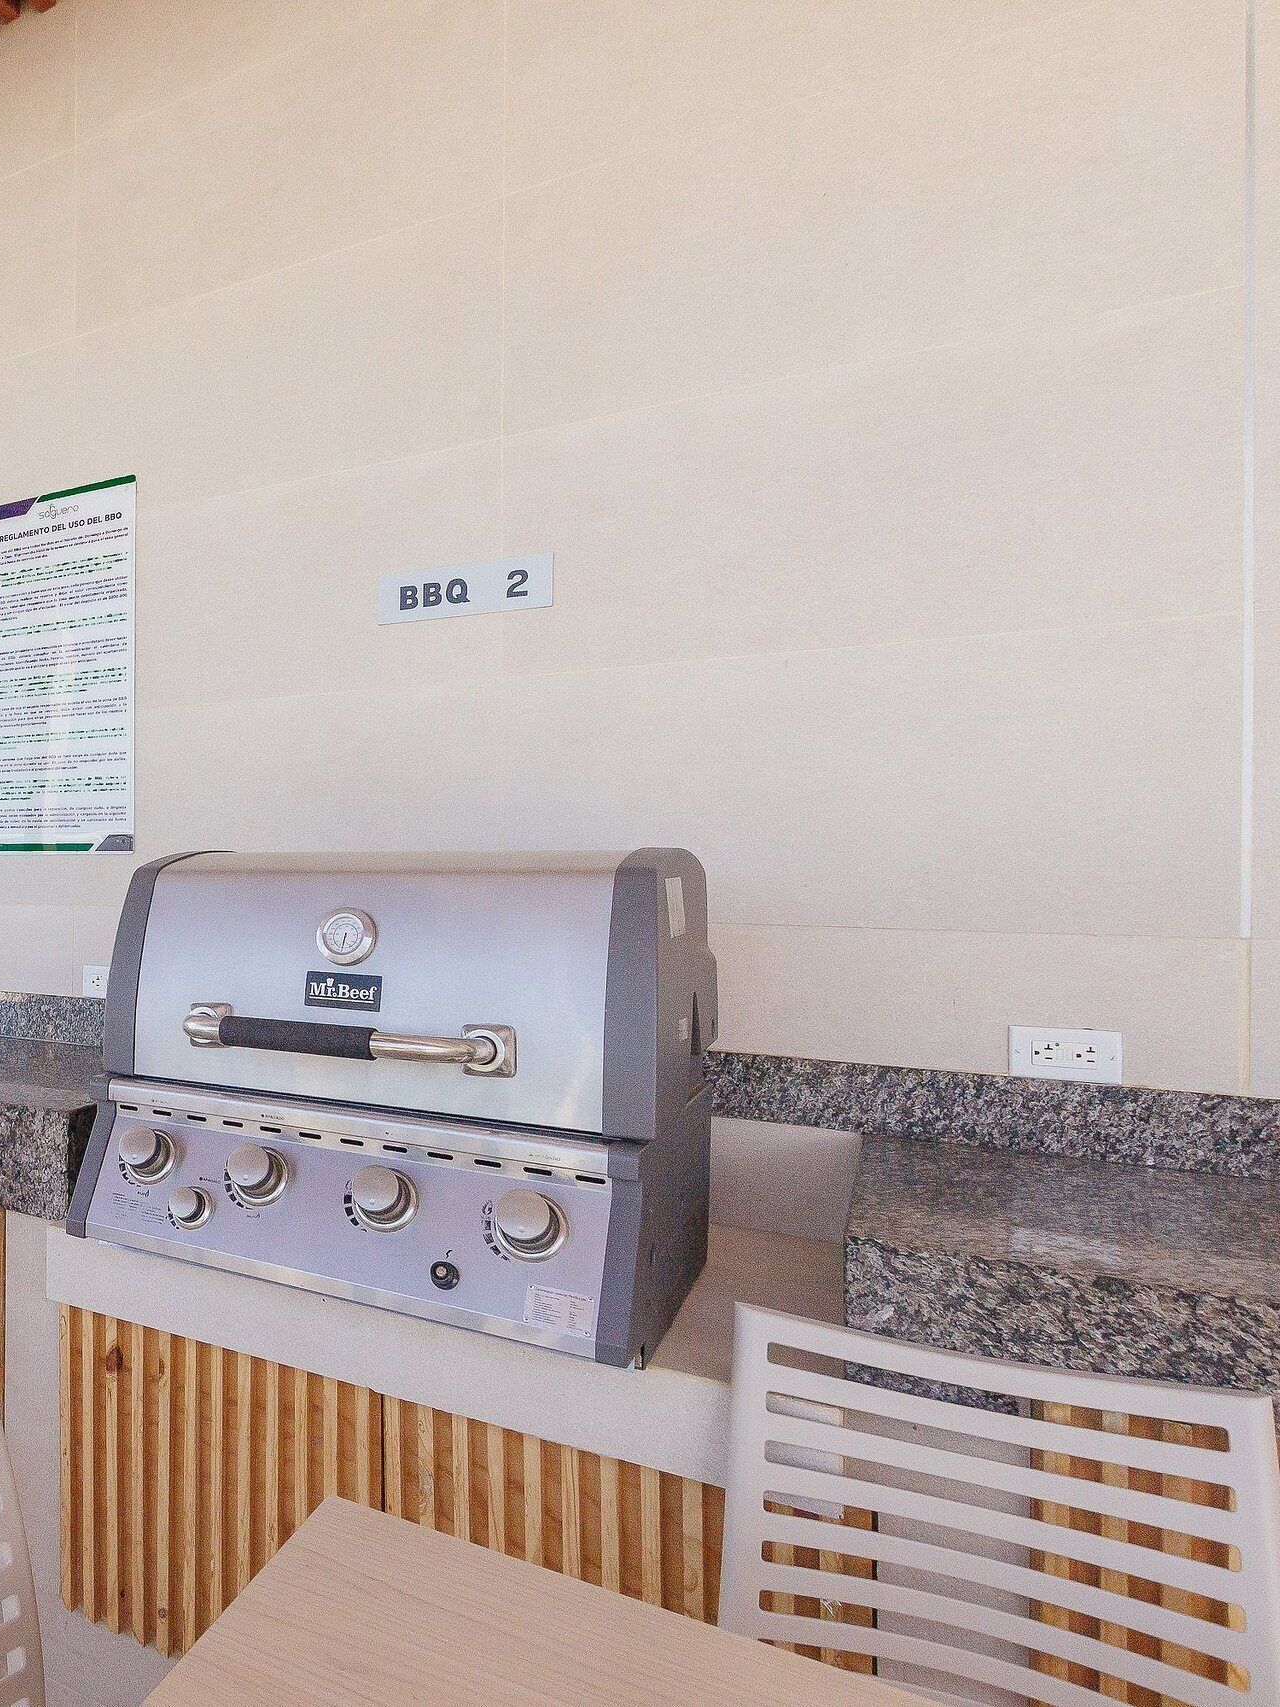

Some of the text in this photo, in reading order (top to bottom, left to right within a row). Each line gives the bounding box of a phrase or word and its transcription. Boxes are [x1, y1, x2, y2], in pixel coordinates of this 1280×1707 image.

[0, 526, 50, 543] REGLAMENTO
[51, 523, 66, 532] DEL
[68, 519, 85, 529] USO
[87, 516, 103, 525] DEL
[399, 569, 529, 611] BBQ 2
